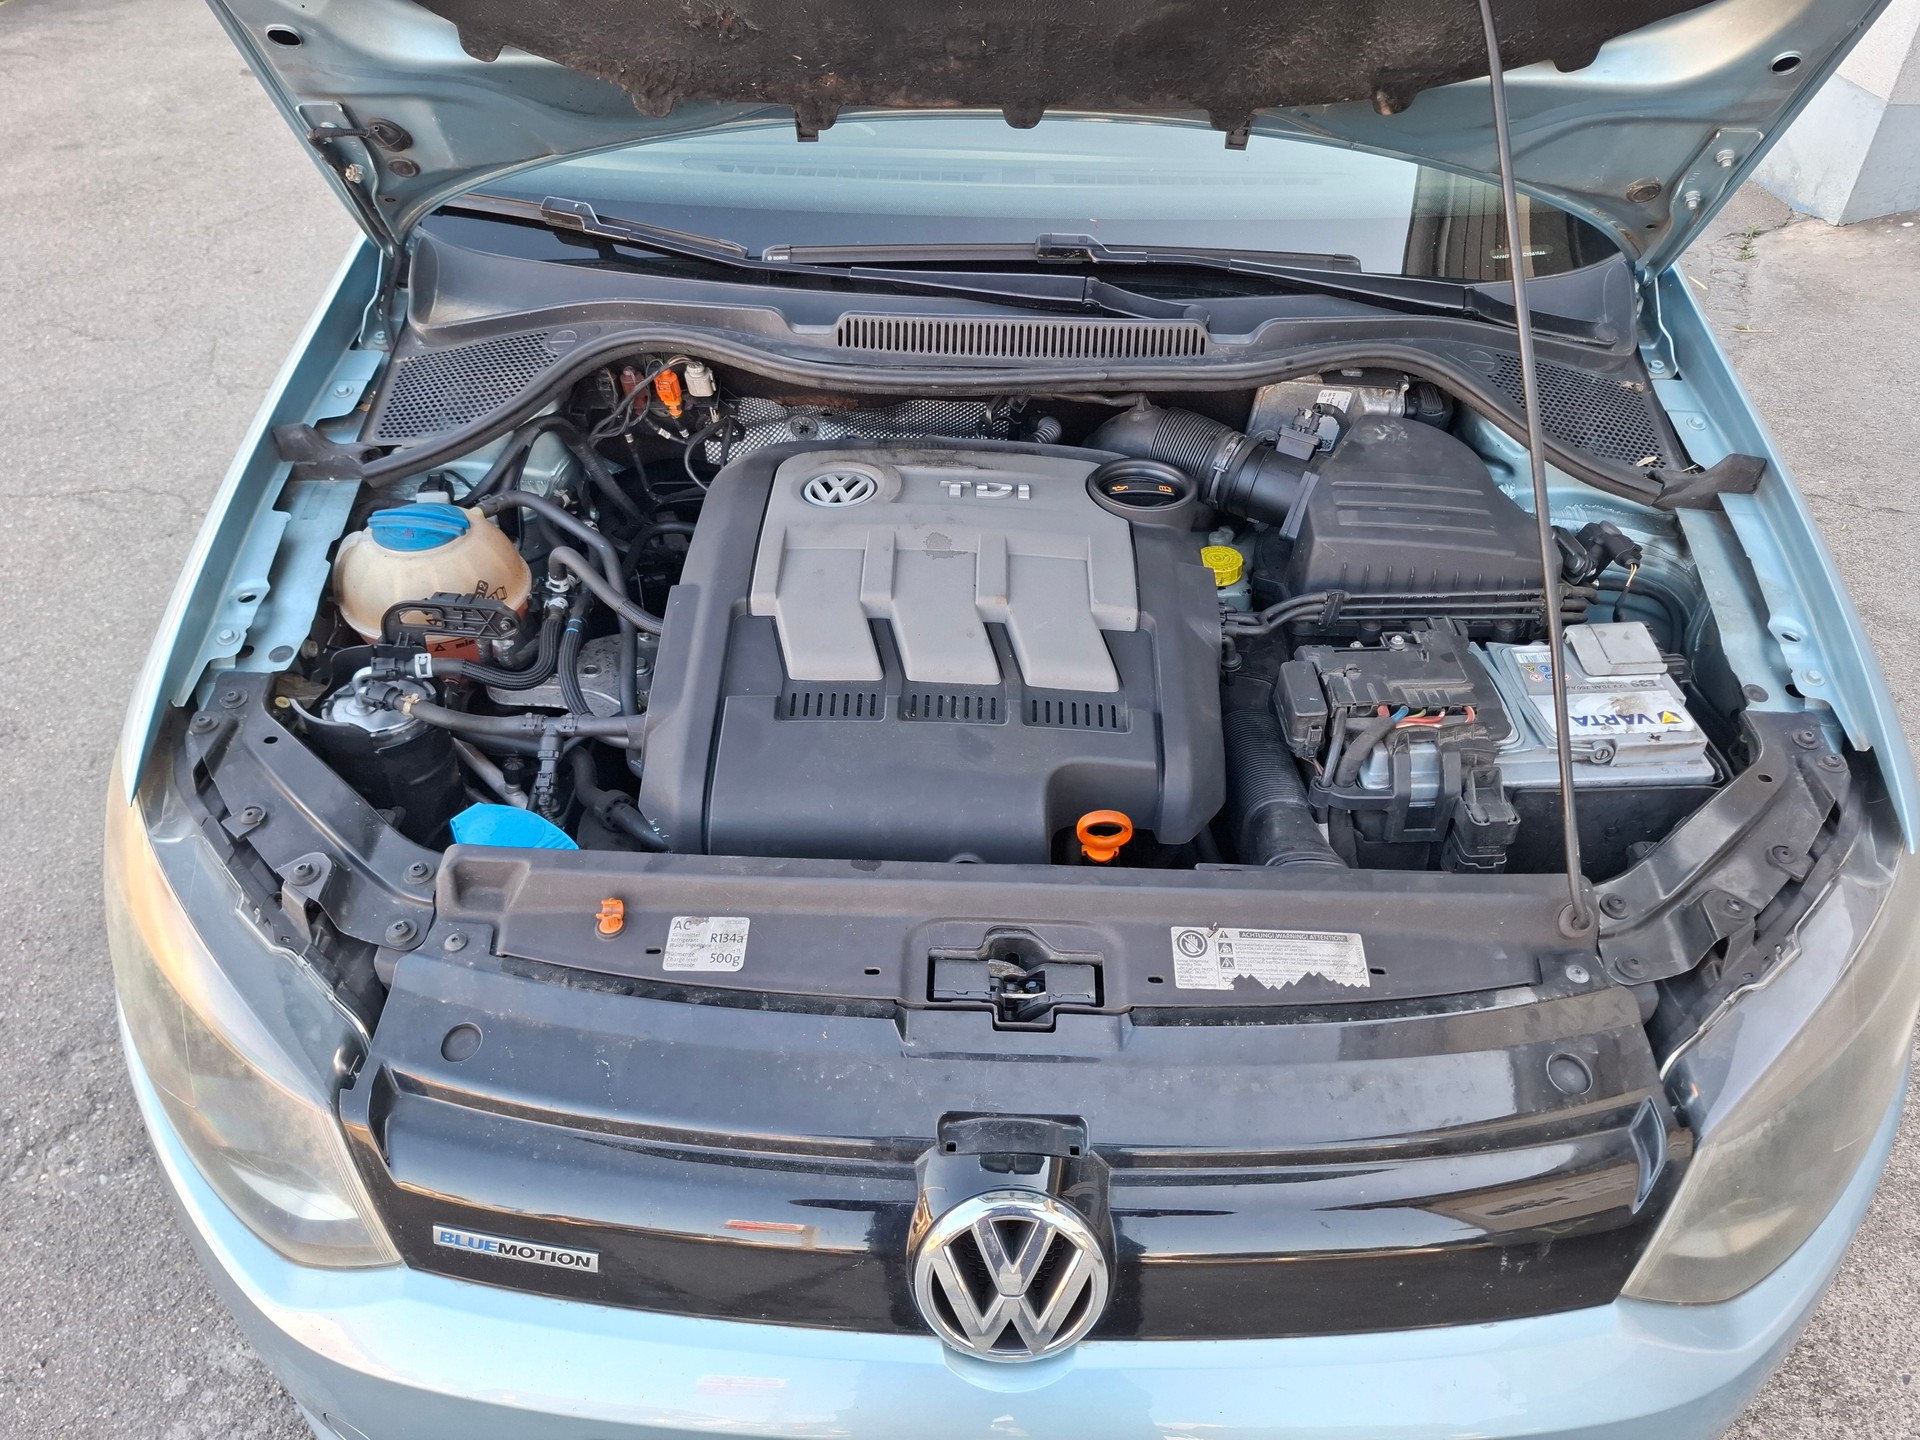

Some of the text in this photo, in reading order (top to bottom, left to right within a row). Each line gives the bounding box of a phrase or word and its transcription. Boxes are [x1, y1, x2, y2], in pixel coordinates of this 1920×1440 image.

[939, 480, 1030, 500] TDI
[456, 639, 475, 648] min
[1631, 680, 1657, 688] E39
[1569, 714, 1656, 727] VARTA
[674, 920, 691, 930] AC
[711, 933, 744, 943] R134a
[1241, 931, 1275, 939] ACHTUNG!
[1310, 934, 1346, 942] ATTENTION!
[709, 953, 740, 967] 500g
[439, 1231, 591, 1268] BLUEMOTION
